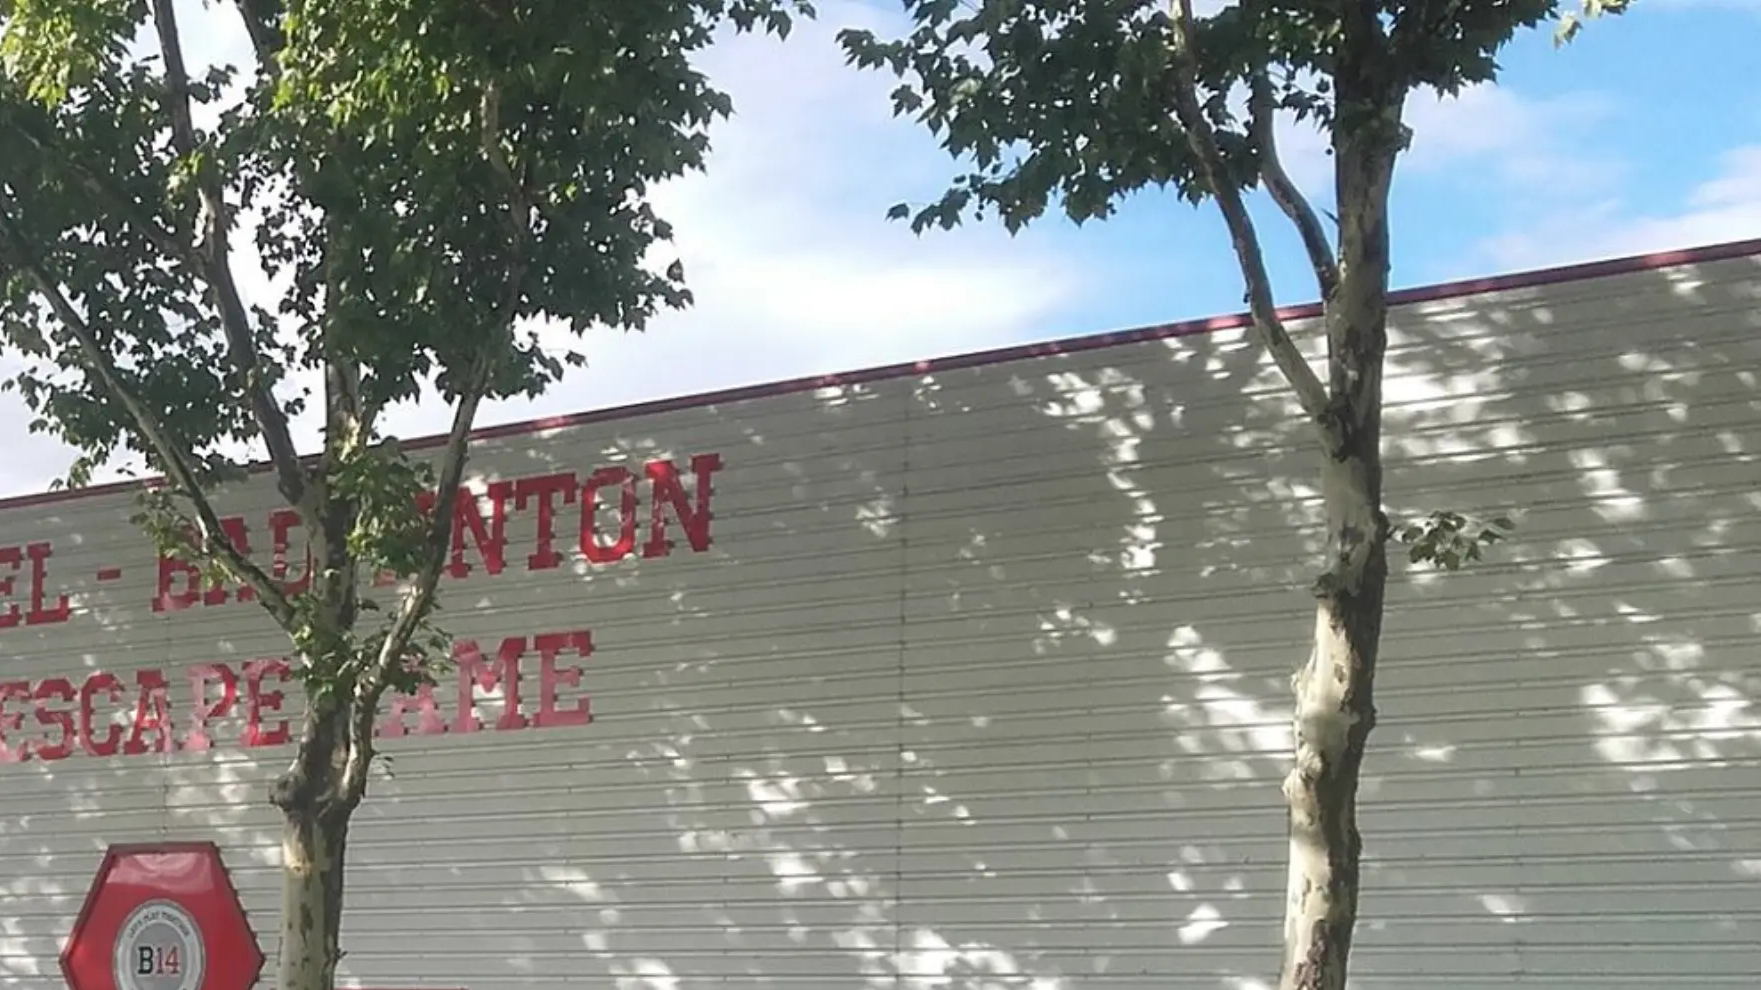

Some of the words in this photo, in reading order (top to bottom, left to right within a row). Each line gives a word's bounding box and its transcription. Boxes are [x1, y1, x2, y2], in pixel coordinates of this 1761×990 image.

[152, 453, 723, 612] BADNTON
[372, 630, 595, 738] AME
[137, 946, 180, 975] B14
